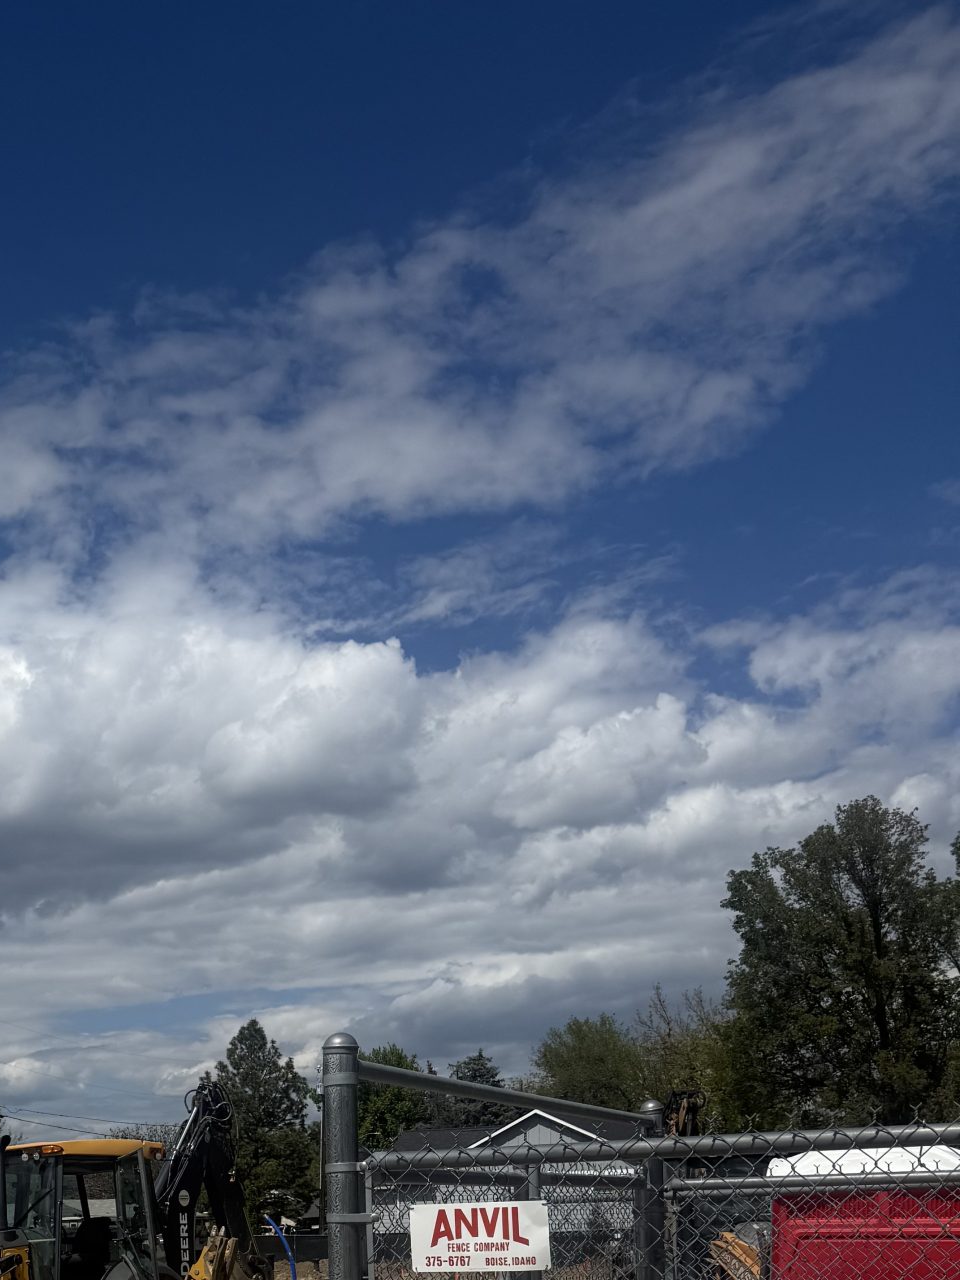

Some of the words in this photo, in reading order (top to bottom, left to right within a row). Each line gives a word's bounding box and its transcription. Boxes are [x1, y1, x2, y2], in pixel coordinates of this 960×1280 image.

[430, 1206, 530, 1247] ANVIL
[180, 1212, 190, 1276] DEERE
[447, 1242, 471, 1252] FENCE
[473, 1241, 510, 1252] COMPANY
[425, 1255, 471, 1267] 375-6767
[485, 1257, 511, 1267] BOISE,
[511, 1256, 537, 1266] IDAHO
